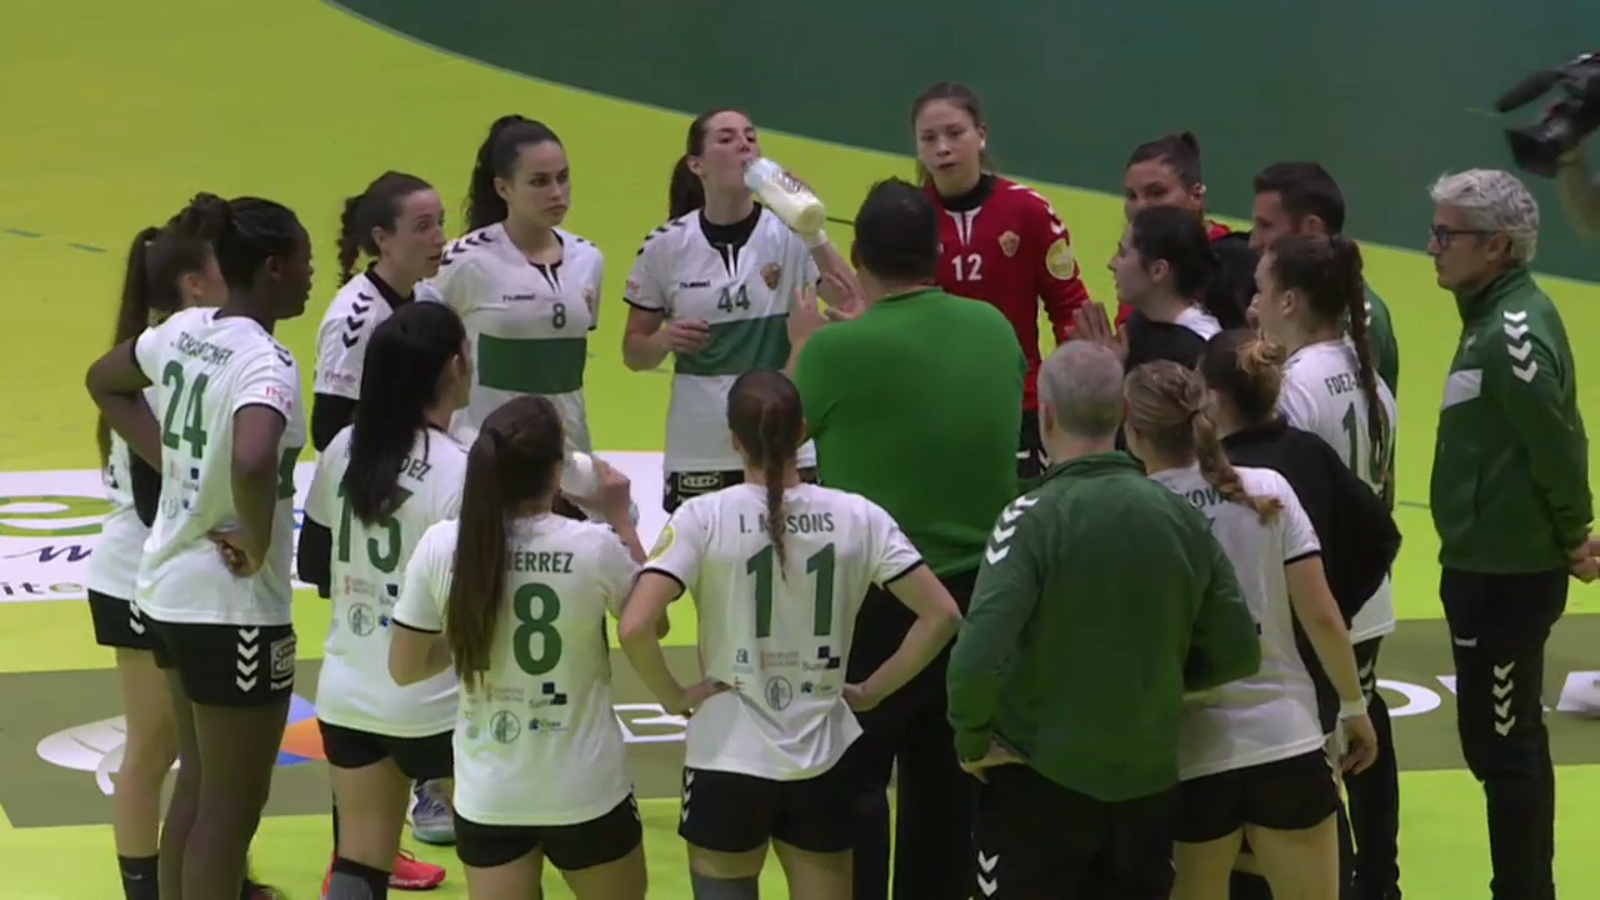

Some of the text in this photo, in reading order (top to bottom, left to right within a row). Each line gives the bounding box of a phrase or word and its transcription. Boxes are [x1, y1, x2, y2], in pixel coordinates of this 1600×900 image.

[952, 253, 982, 281] 12
[717, 283, 750, 313] 44
[552, 303, 566, 329] 8
[1324, 371, 1361, 396] FDEZ-
[162, 360, 209, 459] 24
[747, 541, 835, 639] 11
[513, 583, 562, 675] 8
